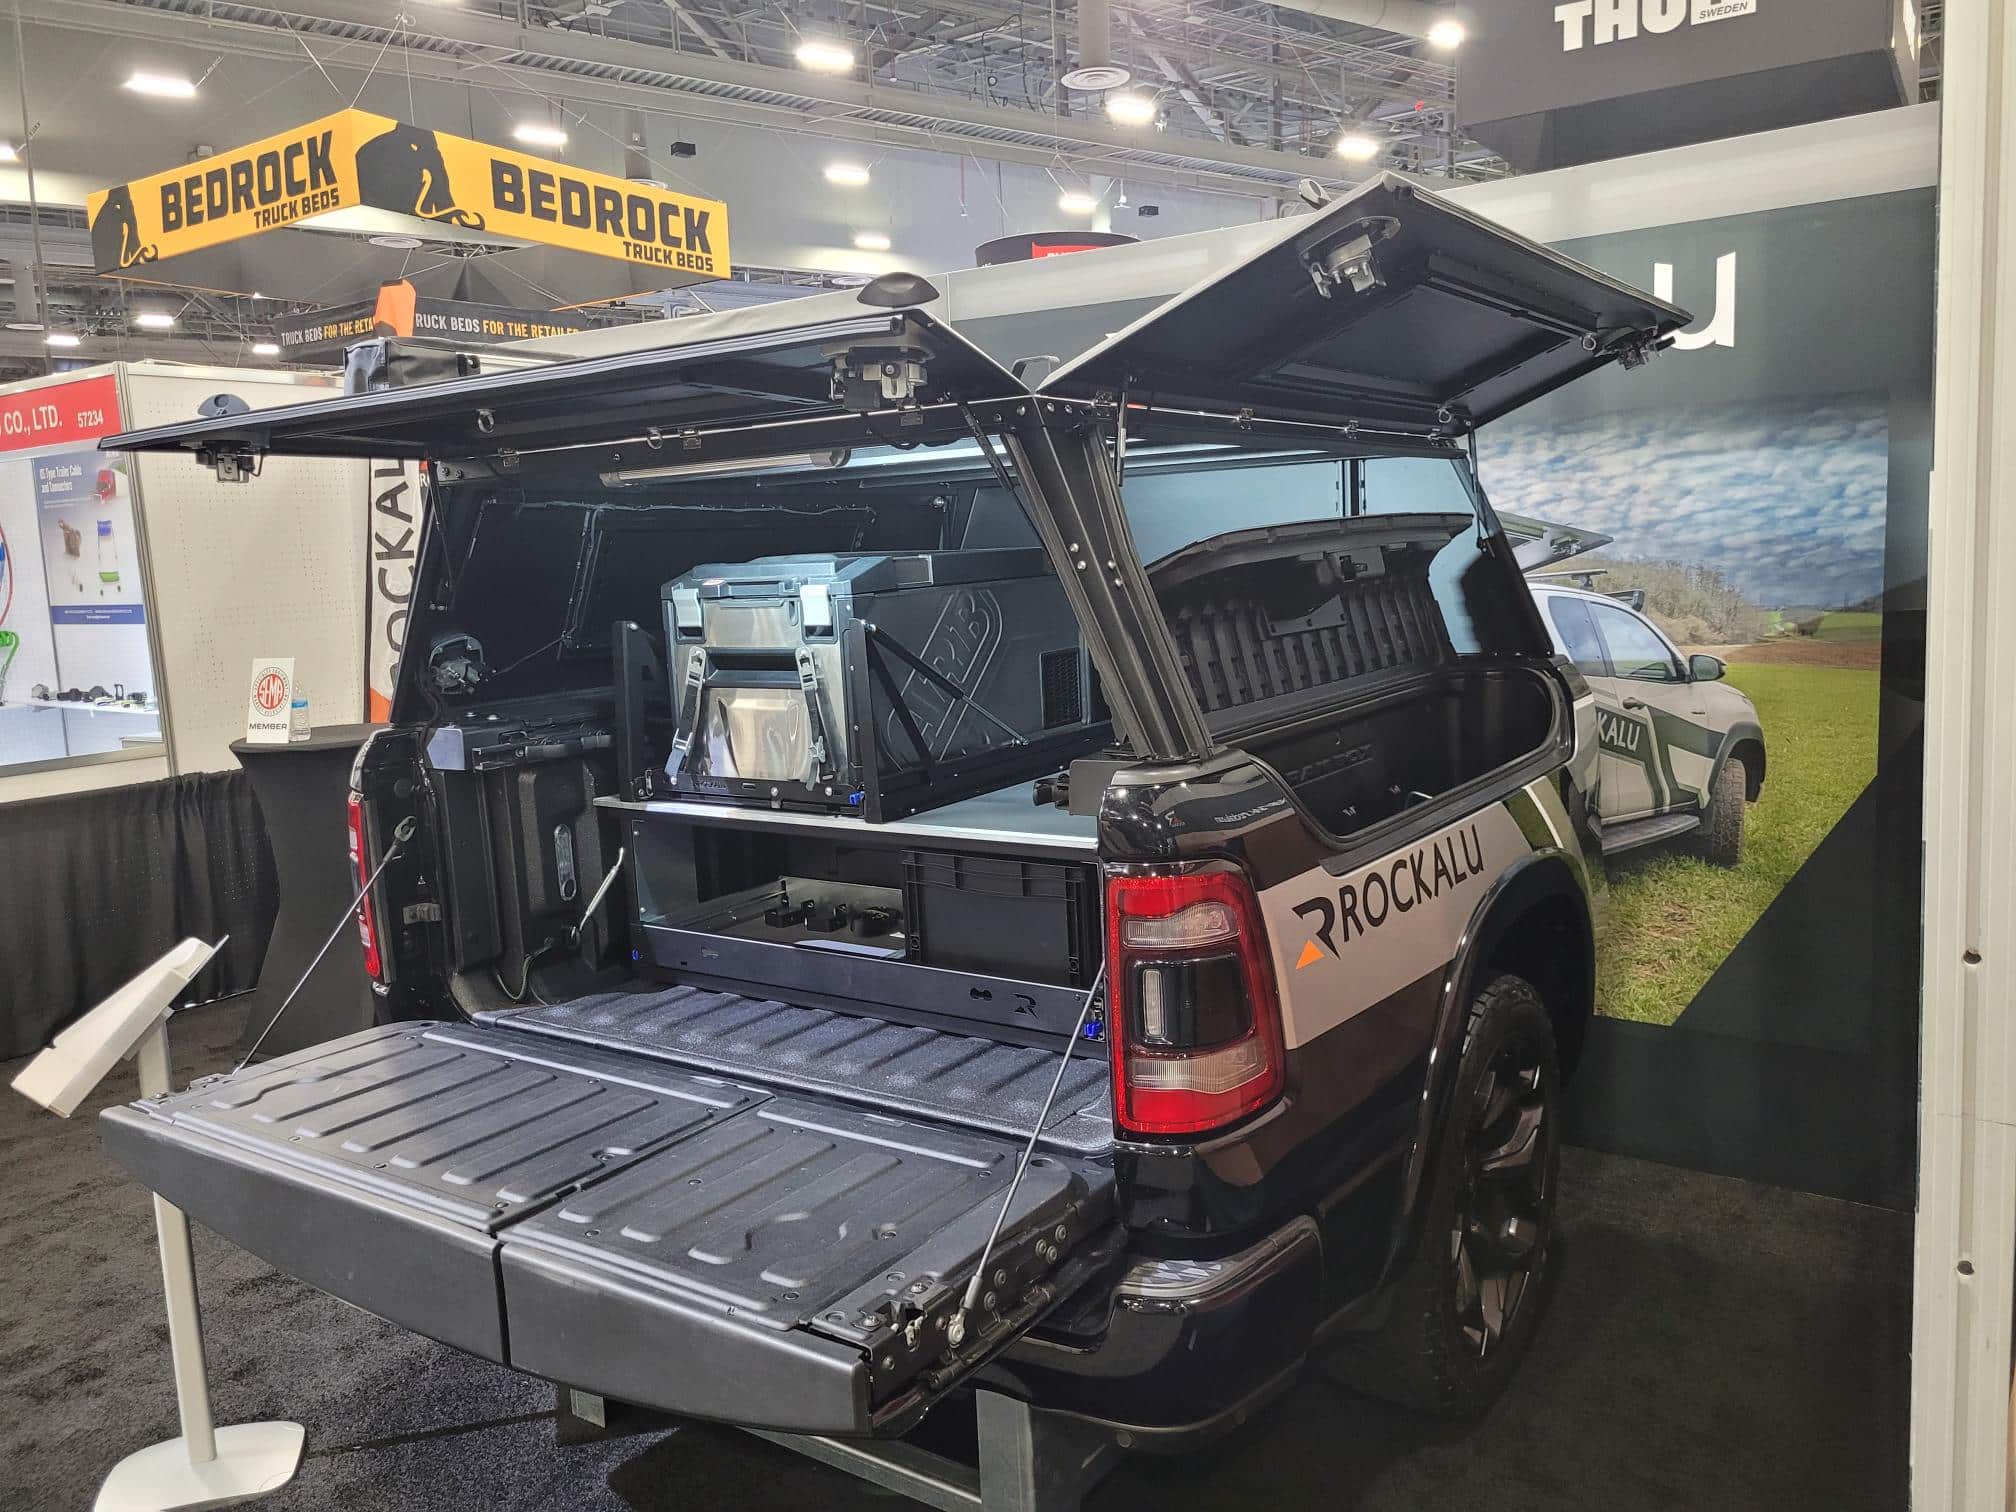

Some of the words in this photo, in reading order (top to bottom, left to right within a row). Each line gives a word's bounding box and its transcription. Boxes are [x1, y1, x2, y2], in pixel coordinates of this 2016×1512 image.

[1554, 0, 1757, 51] THU
[1699, 2, 1748, 19] SWEDEN
[160, 130, 338, 233] BEDROCK
[253, 199, 298, 229] TRUCK
[301, 187, 339, 215] BEDS
[490, 158, 712, 254] BEDROCK
[622, 241, 673, 266] TRUCK
[677, 252, 713, 272] BEDS
[281, 329, 303, 347] TRUCK
[305, 326, 322, 343] BEDS
[323, 324, 338, 339] FOR
[339, 321, 353, 336] THE
[416, 312, 447, 330] RUCK
[450, 317, 480, 333] BEDS
[482, 319, 505, 335] FOR
[507, 322, 528, 338] THE
[32, 405, 63, 430] LTD.
[77, 408, 104, 428] 57234
[258, 674, 284, 709] SEMA
[1338, 824, 1484, 943] ROCKALU
